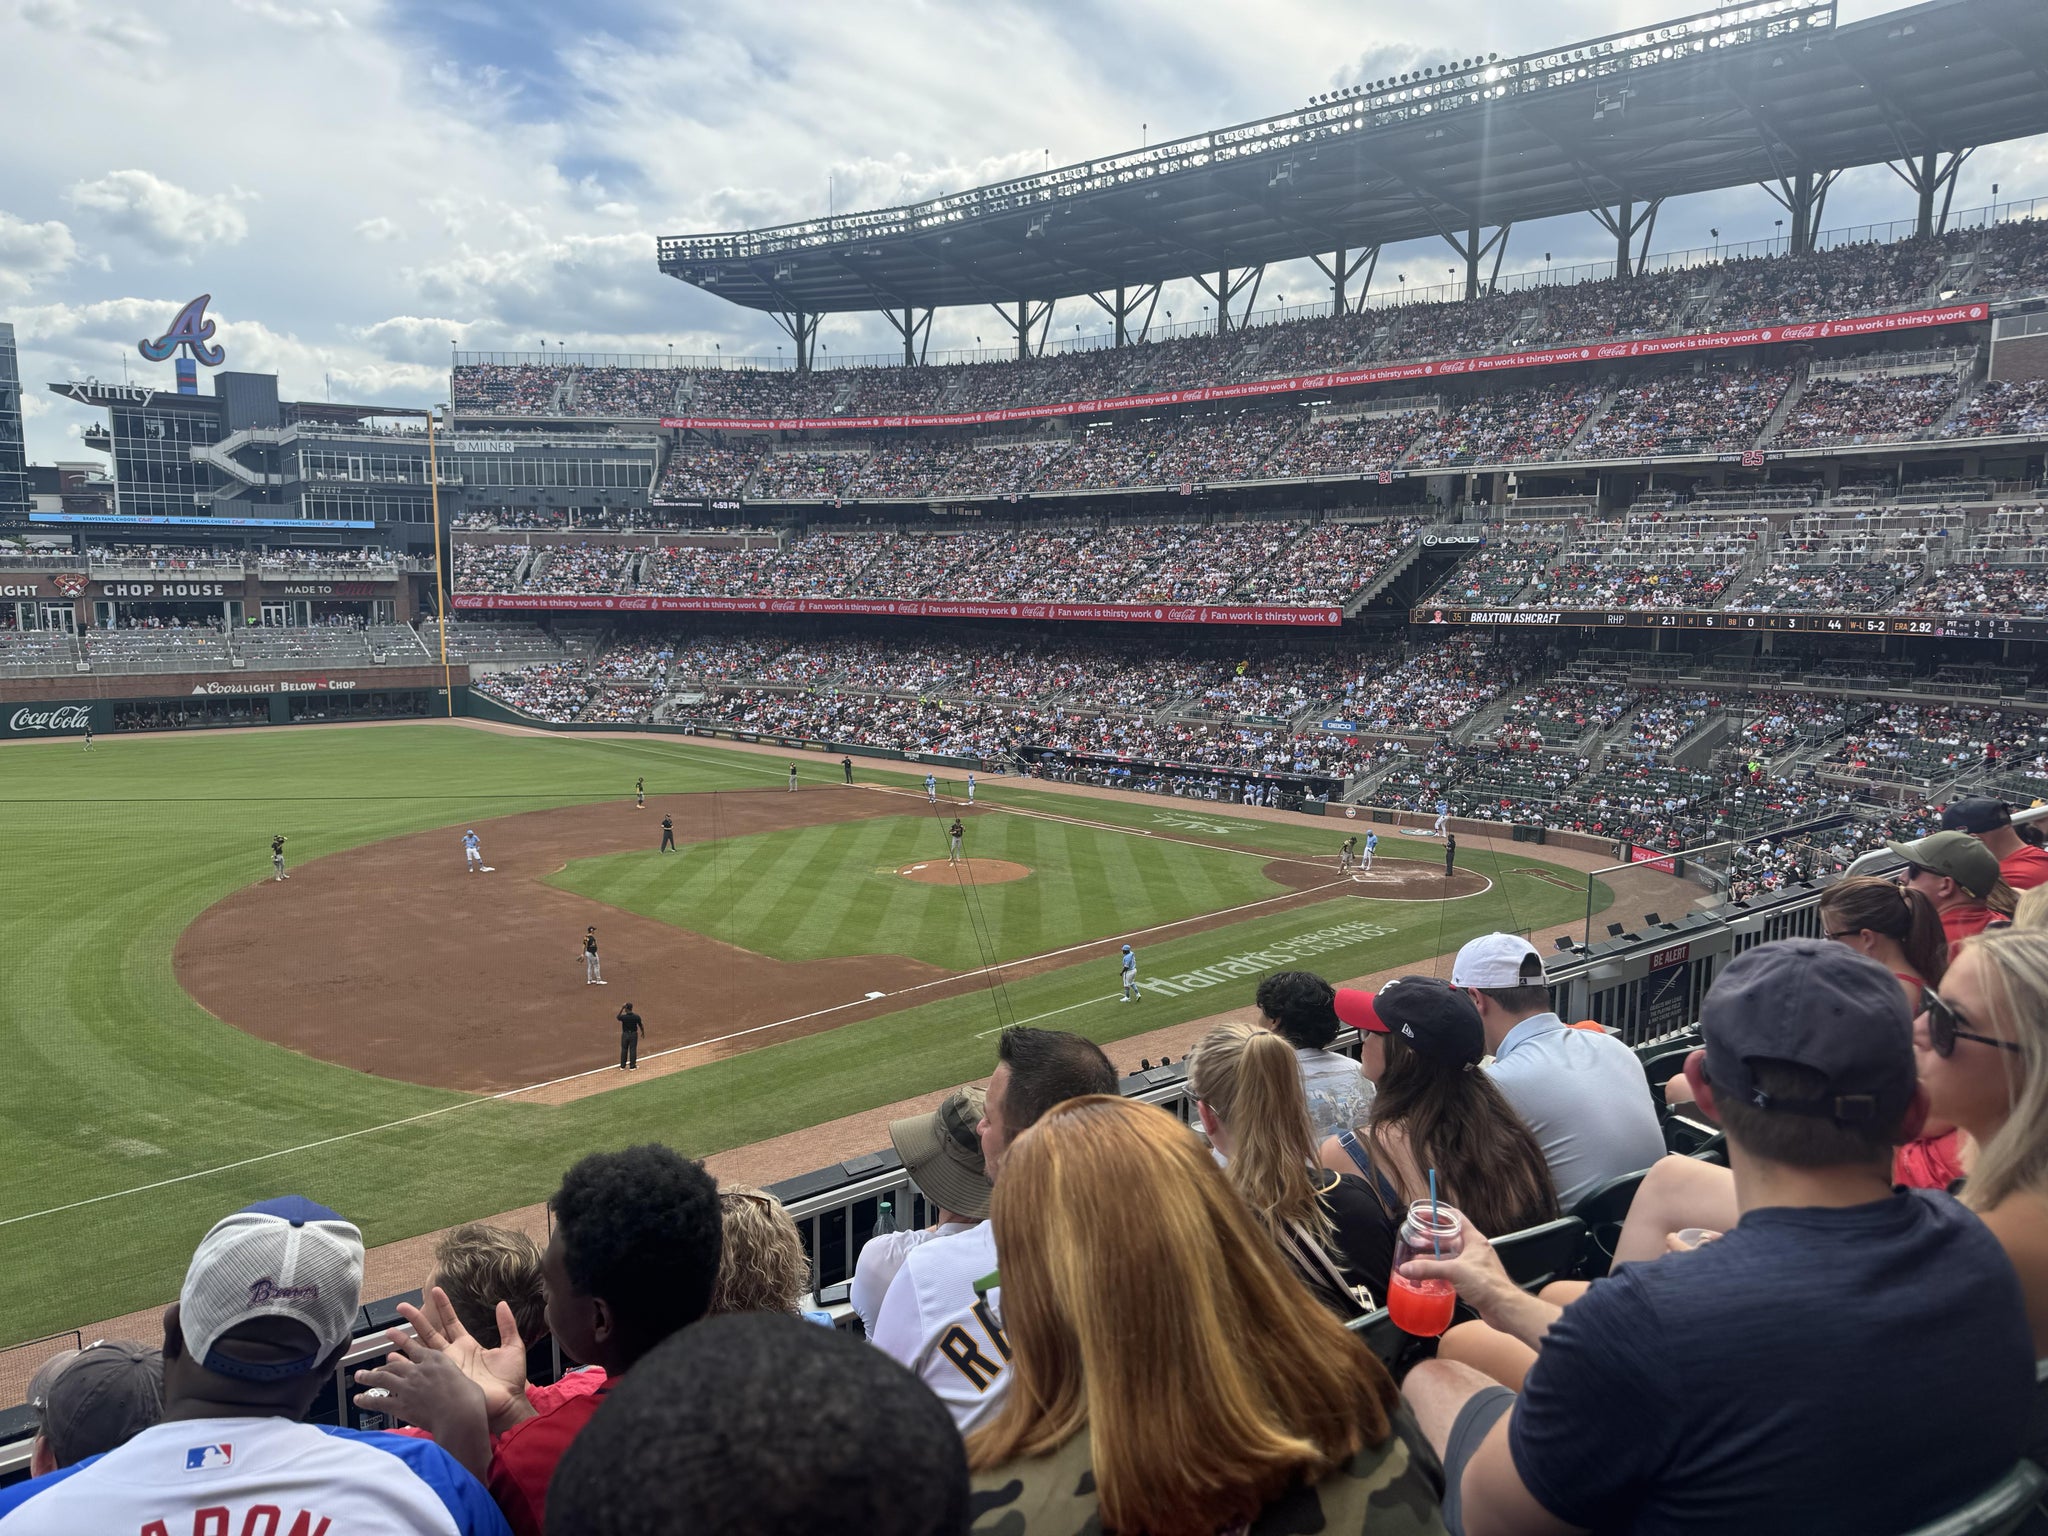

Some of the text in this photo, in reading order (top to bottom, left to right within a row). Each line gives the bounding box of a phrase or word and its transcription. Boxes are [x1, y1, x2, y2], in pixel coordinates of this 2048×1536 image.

[1834, 311, 1965, 332] Fan work is thirsty work
[138, 294, 225, 366] A
[1698, 336, 1730, 346] thirsty
[1733, 334, 1758, 342] work
[1526, 354, 1554, 363] thirsty
[1378, 370, 1401, 379] thirsty
[68, 376, 155, 406] xfinity
[1248, 384, 1269, 393] thirsty
[468, 442, 512, 452] MILNER
[1742, 450, 1764, 466] 25
[1379, 470, 1392, 484] 21
[835, 499, 841, 508] 3
[104, 584, 224, 596] CHOP HOUSE
[967, 606, 988, 615] thirsty
[1102, 609, 1128, 618] thirsty
[1230, 612, 1252, 620] work
[1255, 612, 1262, 620] is
[1265, 612, 1296, 622] thirsty
[1299, 613, 1324, 621] work
[1452, 612, 1624, 624] 35 BRAXTON ASHCRAFT RHP
[1662, 616, 1675, 625] 2.1
[1707, 617, 1713, 626] 5
[1748, 618, 1754, 626] 0
[1789, 619, 1795, 628] 3
[1828, 620, 1841, 629] 44
[1868, 621, 1885, 631] 5-2
[1910, 622, 1931, 632] 2.92
[207, 682, 275, 694] Coors LIGHT
[281, 682, 316, 691] BELOW
[329, 681, 356, 690] CHOP
[10, 705, 93, 731] Coca-Cola
[1270, 920, 1373, 950] CHEROKEE
[1294, 926, 1398, 956] CASINOS
[1653, 946, 1686, 967] BE ALERT
[247, 1276, 320, 1310] Braves
